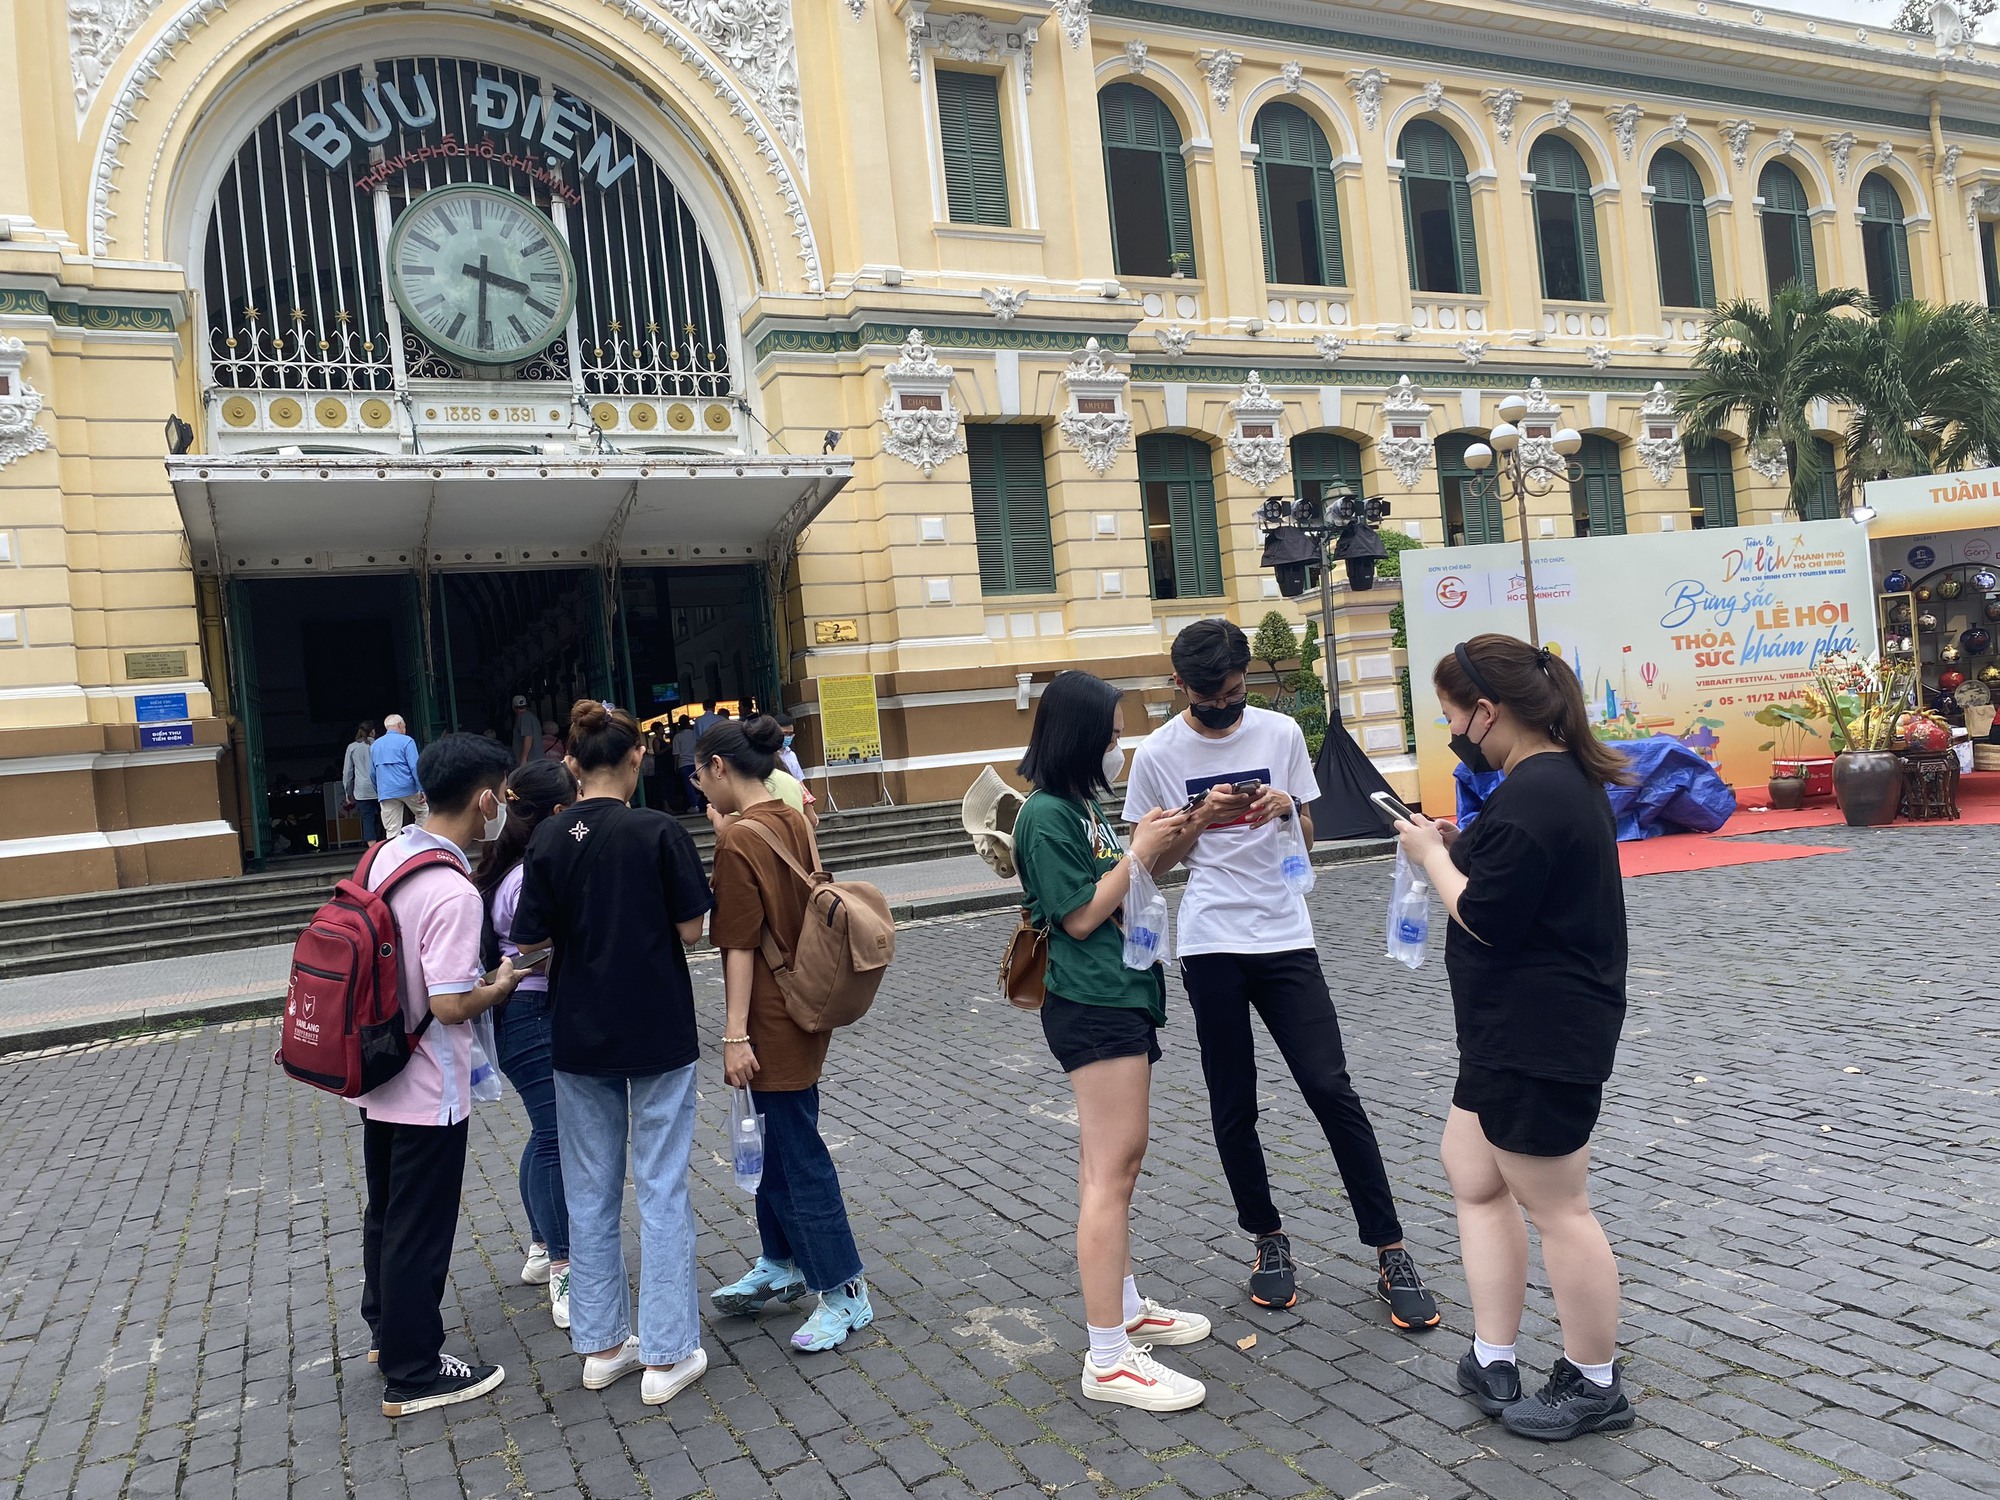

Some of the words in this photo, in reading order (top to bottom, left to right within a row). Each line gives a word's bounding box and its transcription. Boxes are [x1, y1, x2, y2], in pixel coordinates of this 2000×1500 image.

[470, 76, 636, 190] ĐIỆN
[416, 133, 459, 161] PHỐ
[465, 135, 494, 158] HỒ
[501, 152, 539, 174] CHÍ
[536, 167, 581, 204] MINH
[444, 406, 482, 421] 1886
[505, 407, 536, 422] 1891
[1929, 477, 1987, 503] TUẦN
[1824, 559, 1846, 567] MINH
[1553, 590, 1570, 598] CITY
[1660, 579, 1737, 628] Bừng
[1741, 581, 1776, 613] sắc
[1755, 601, 1790, 630] LỄ
[1795, 600, 1849, 628] HỘI
[833, 623, 841, 633] 2
[1671, 628, 1735, 651] THỎA
[1740, 625, 1808, 666] khám
[1809, 625, 1857, 670] phá
[1694, 648, 1735, 668] SỨC
[1696, 678, 1732, 687] VIBRANT
[1735, 674, 1777, 684] FESTIVAL,
[1780, 671, 1816, 680] VIBRANT
[1719, 697, 1734, 705] 05
[1746, 692, 1775, 703] 11/12
